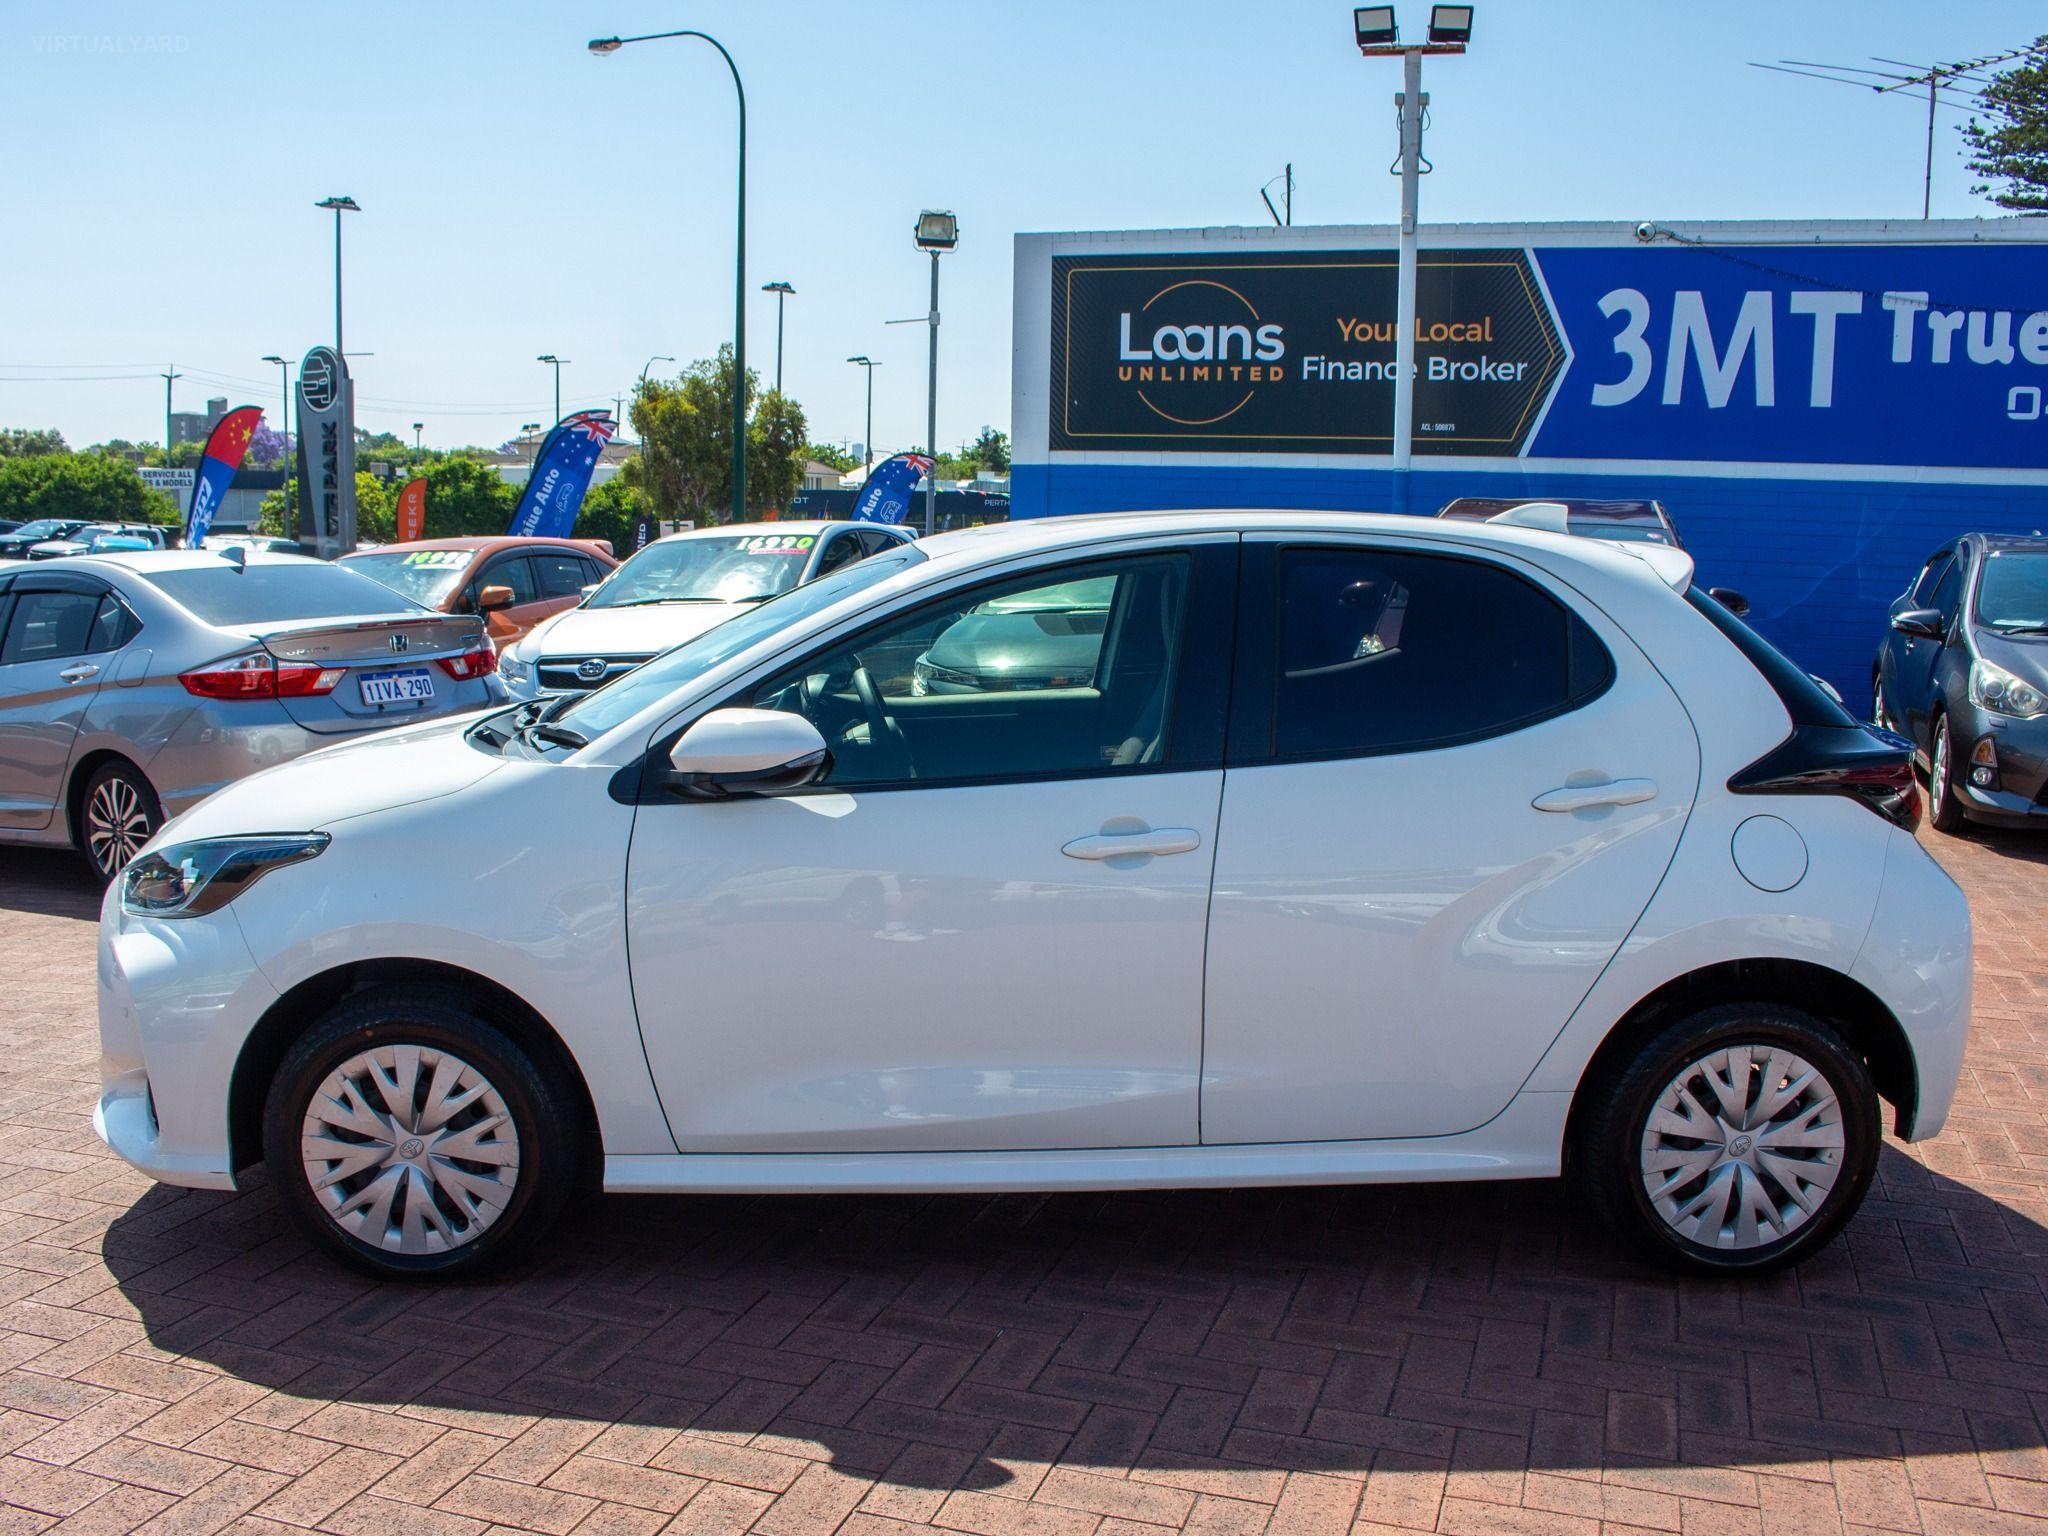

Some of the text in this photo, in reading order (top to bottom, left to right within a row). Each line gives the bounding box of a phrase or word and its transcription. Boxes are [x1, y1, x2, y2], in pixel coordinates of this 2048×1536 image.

[1120, 313, 1285, 361] Loans
[1415, 317, 1493, 342] Local
[1591, 288, 1863, 408] 3MT
[1118, 366, 1284, 382] UNLIMITED
[1428, 355, 1529, 381] Broker
[321, 421, 338, 489] PARK
[142, 471, 176, 479] SERVICE
[162, 479, 193, 487] MODELS
[517, 468, 560, 537] alue Auto
[862, 488, 882, 517] Auto
[736, 536, 814, 550] 16990
